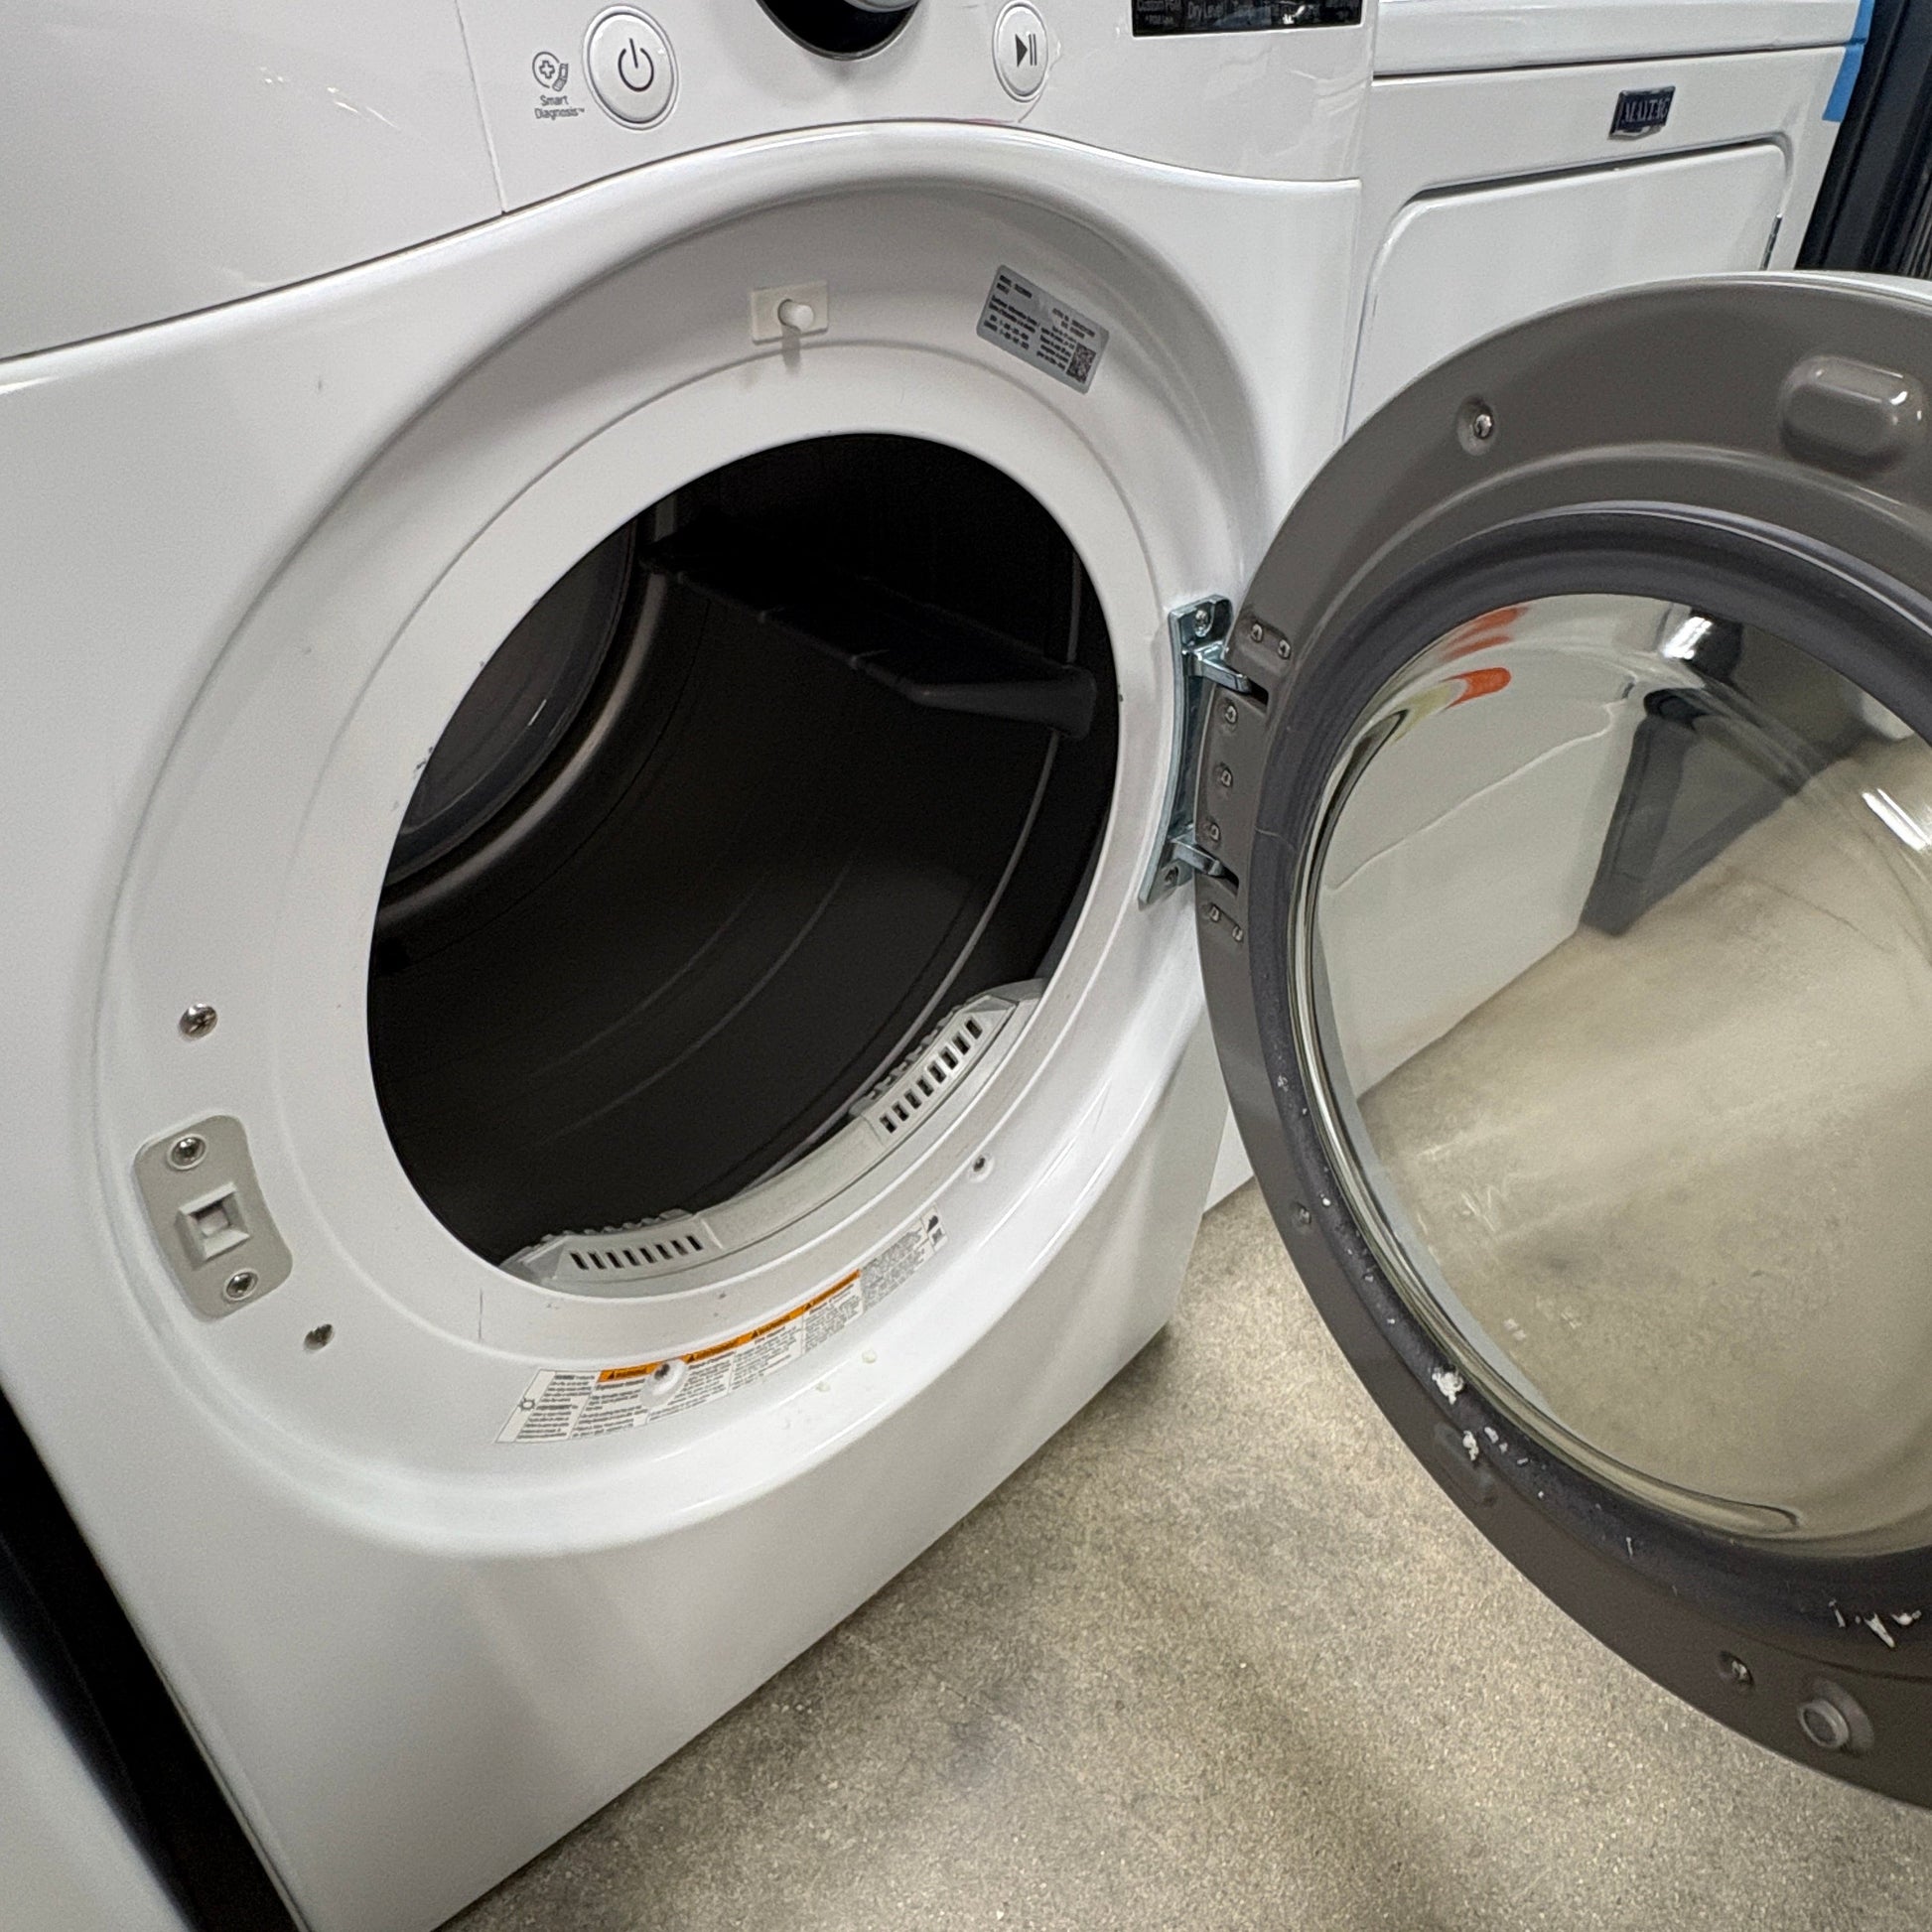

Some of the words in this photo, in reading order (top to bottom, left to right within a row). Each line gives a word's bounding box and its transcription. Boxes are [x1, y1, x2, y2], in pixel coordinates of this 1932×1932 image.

[1187, 1, 1201, 21] Dry
[540, 94, 569, 106] Smart
[1624, 97, 1670, 122] MAYTAG
